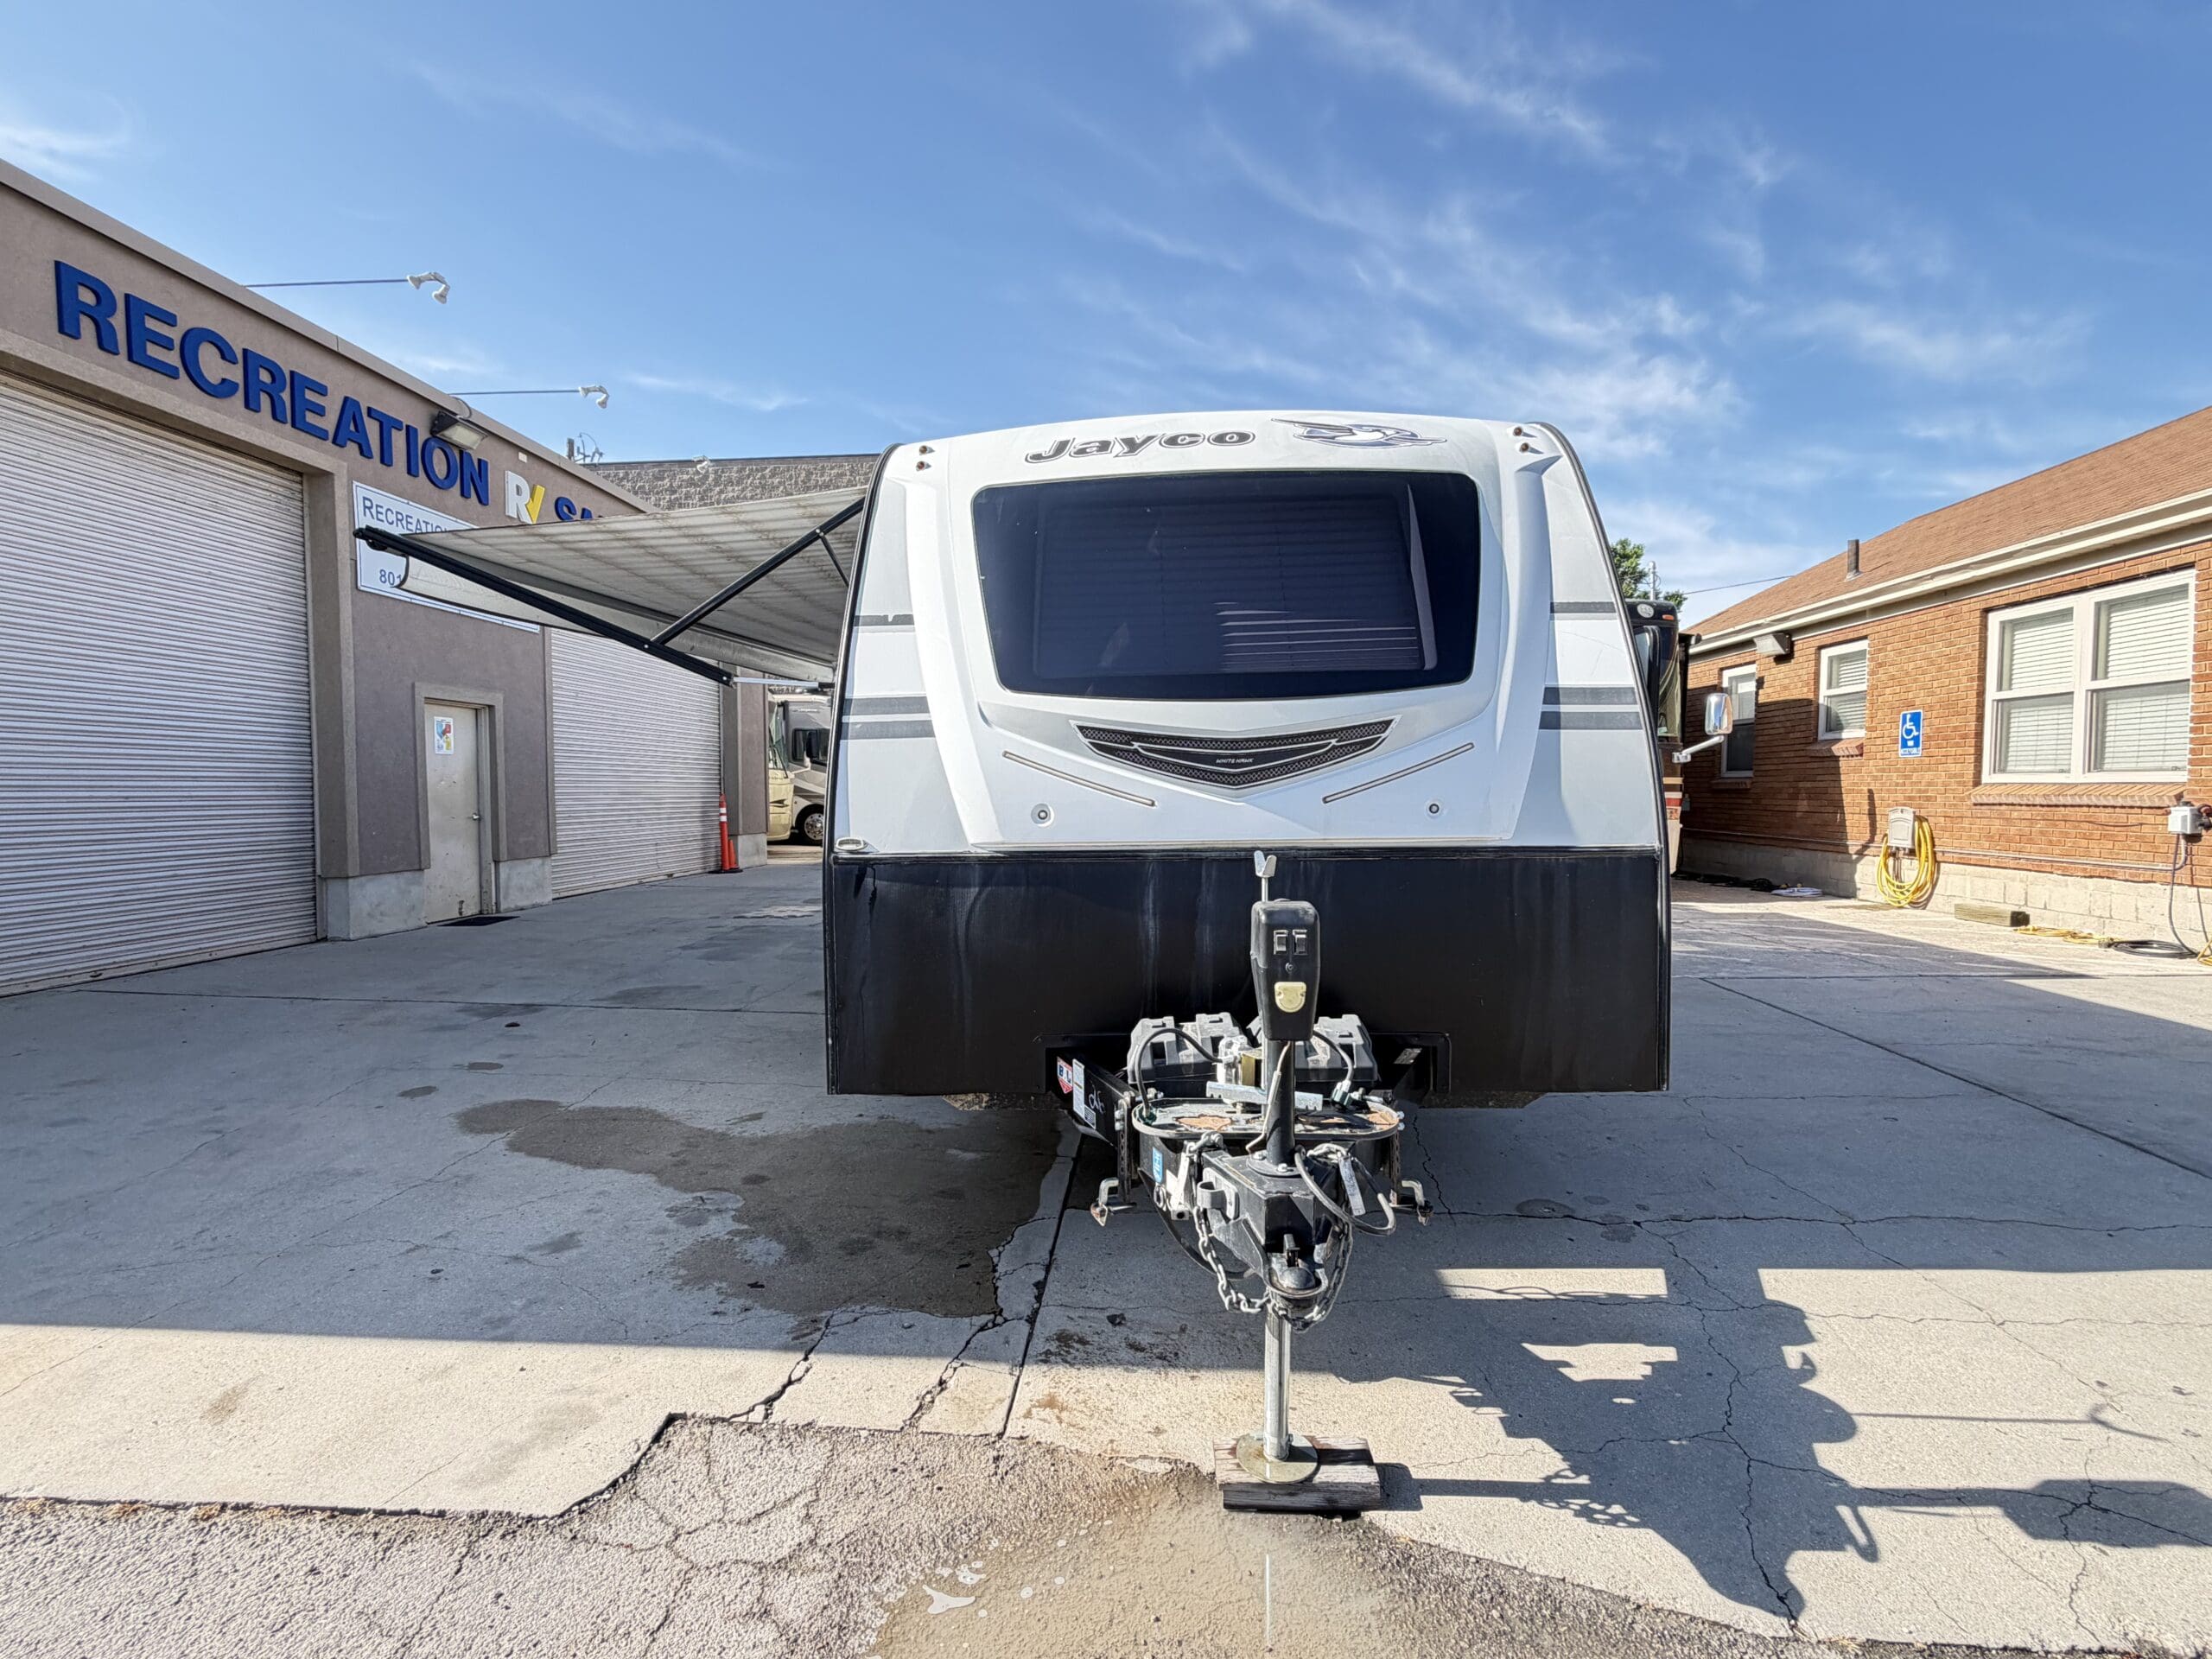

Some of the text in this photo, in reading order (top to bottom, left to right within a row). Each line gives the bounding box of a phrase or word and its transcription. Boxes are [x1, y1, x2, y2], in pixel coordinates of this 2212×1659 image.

[54, 260, 545, 524] RECREATION RV
[1025, 431, 1256, 463] Jayco
[362, 496, 448, 533] RECREATI
